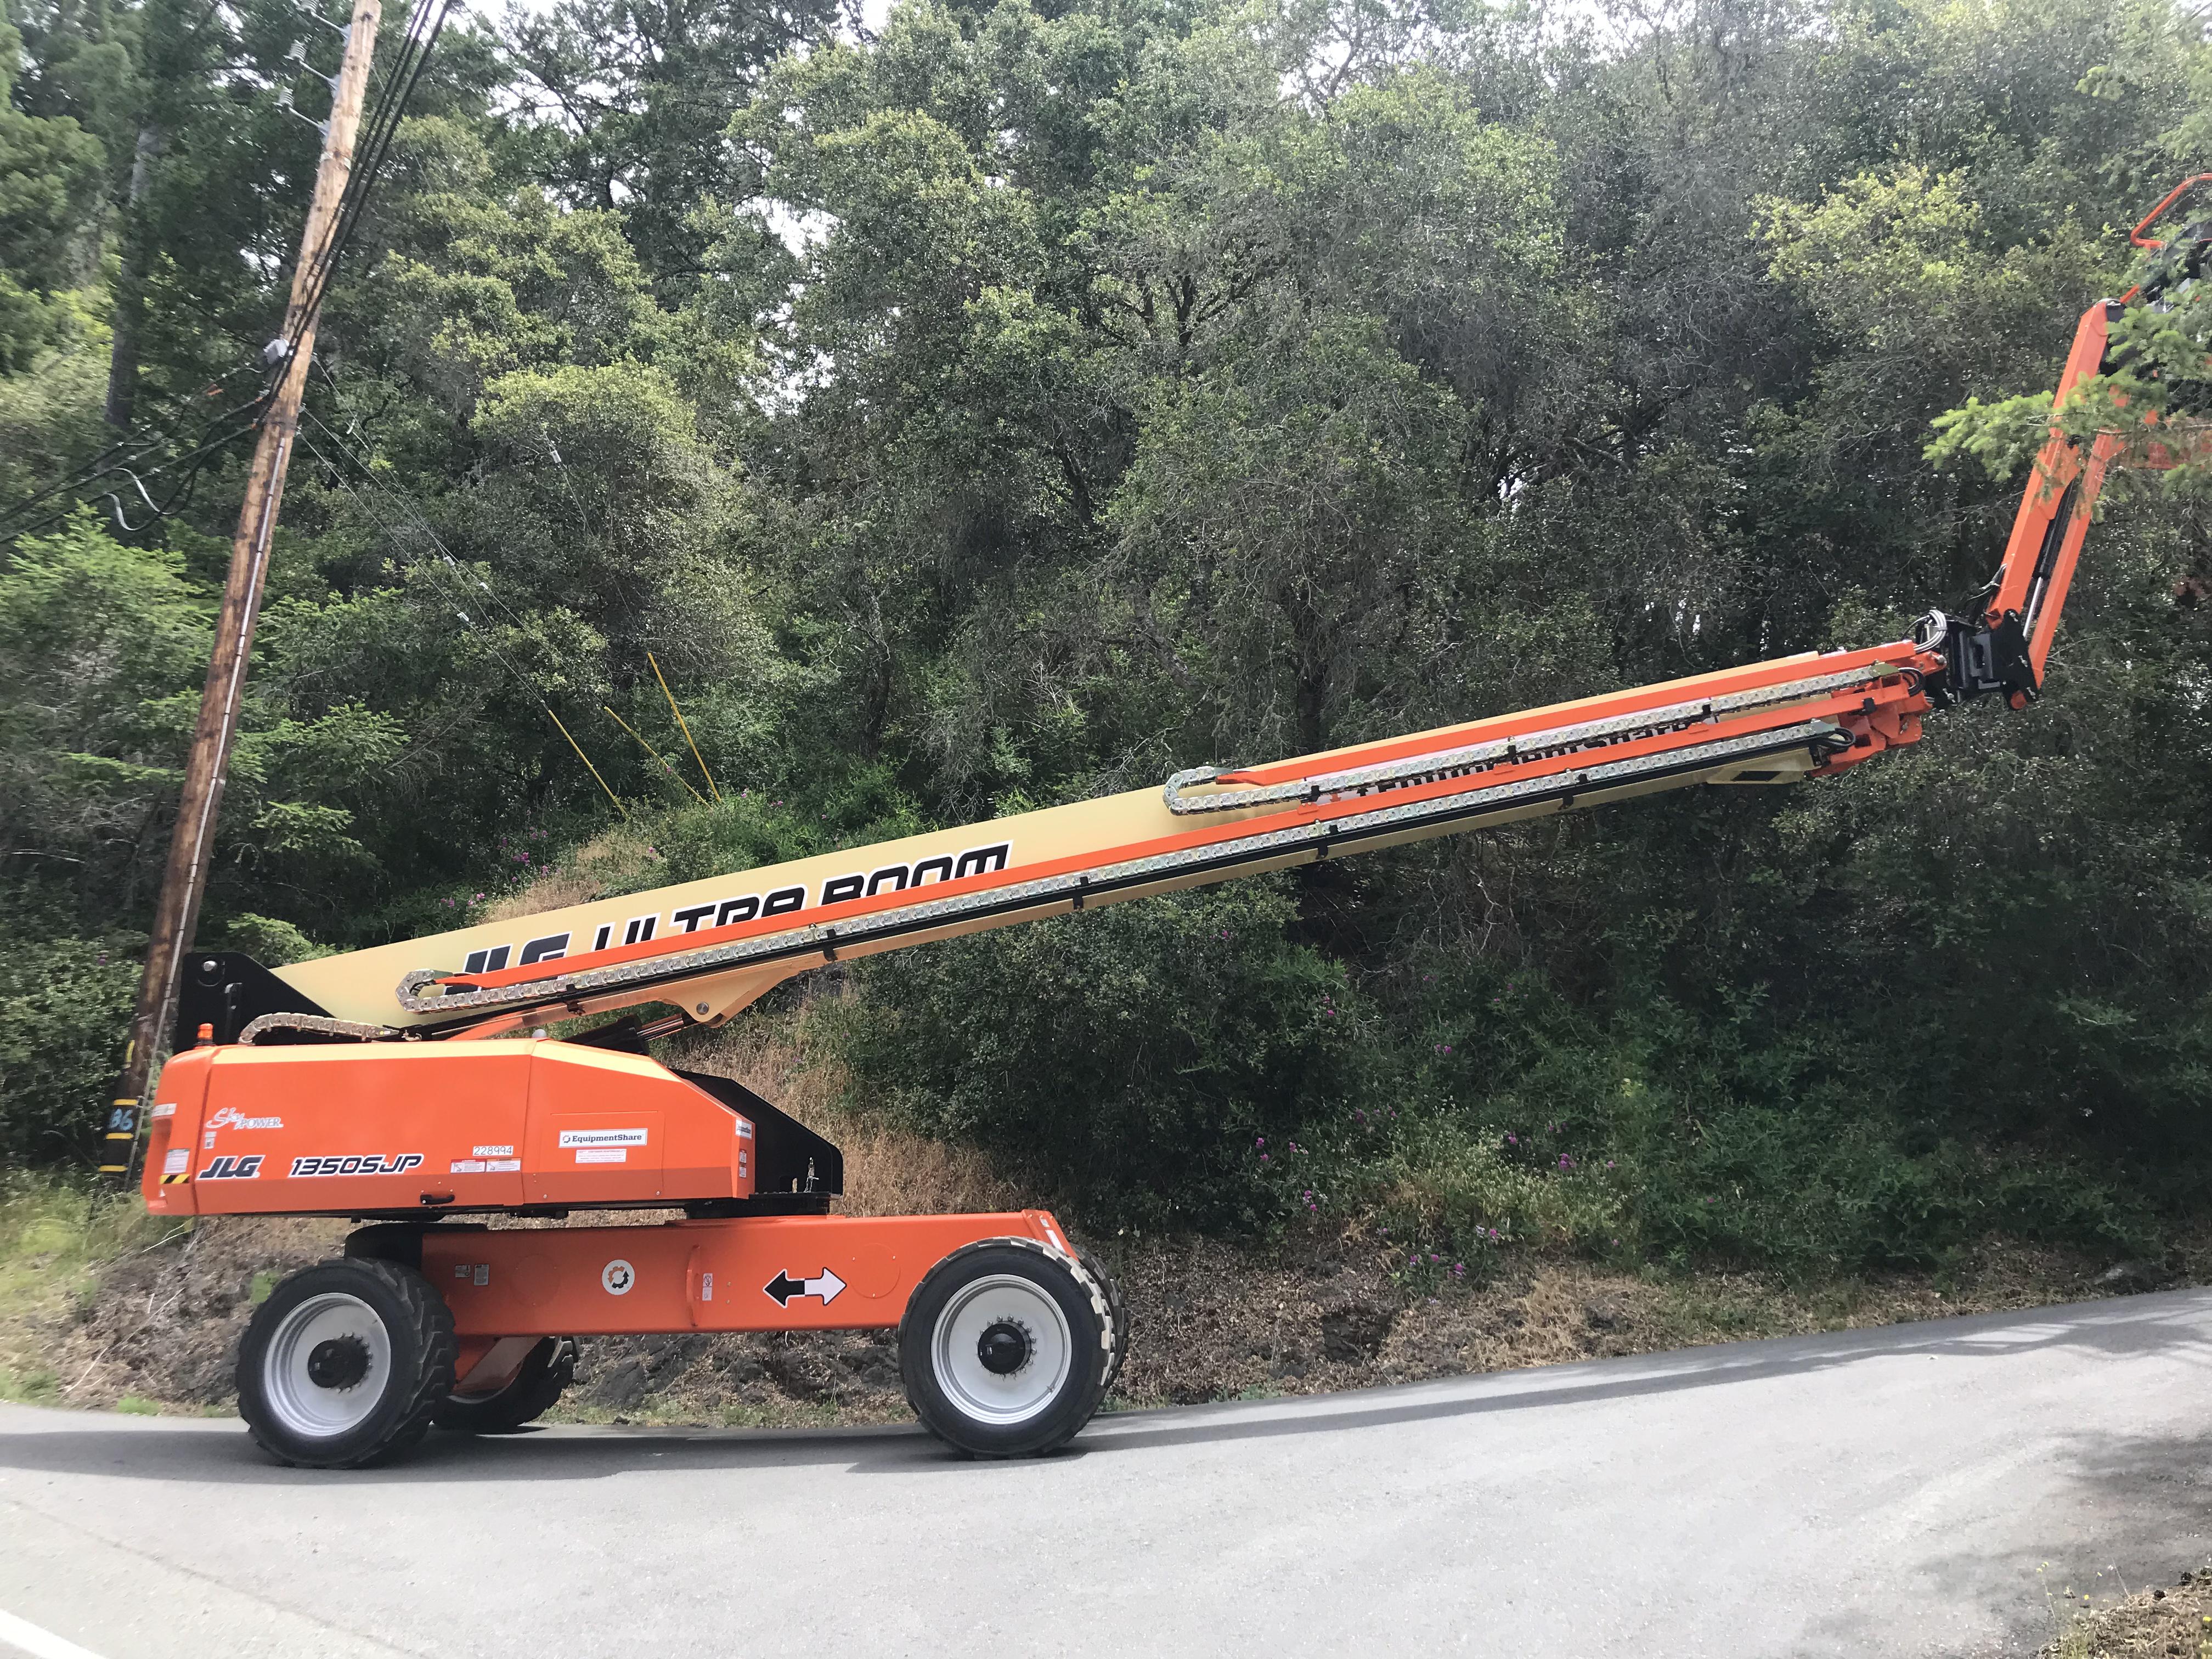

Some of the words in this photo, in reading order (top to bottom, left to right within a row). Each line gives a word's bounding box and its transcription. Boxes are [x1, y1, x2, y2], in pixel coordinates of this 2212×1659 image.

[240, 1117, 283, 1128] POWER
[572, 1134, 642, 1143] EquipmentShare
[473, 1146, 512, 1155] 228994
[198, 1155, 264, 1180] JLG
[289, 1154, 423, 1177] 1350SJP
